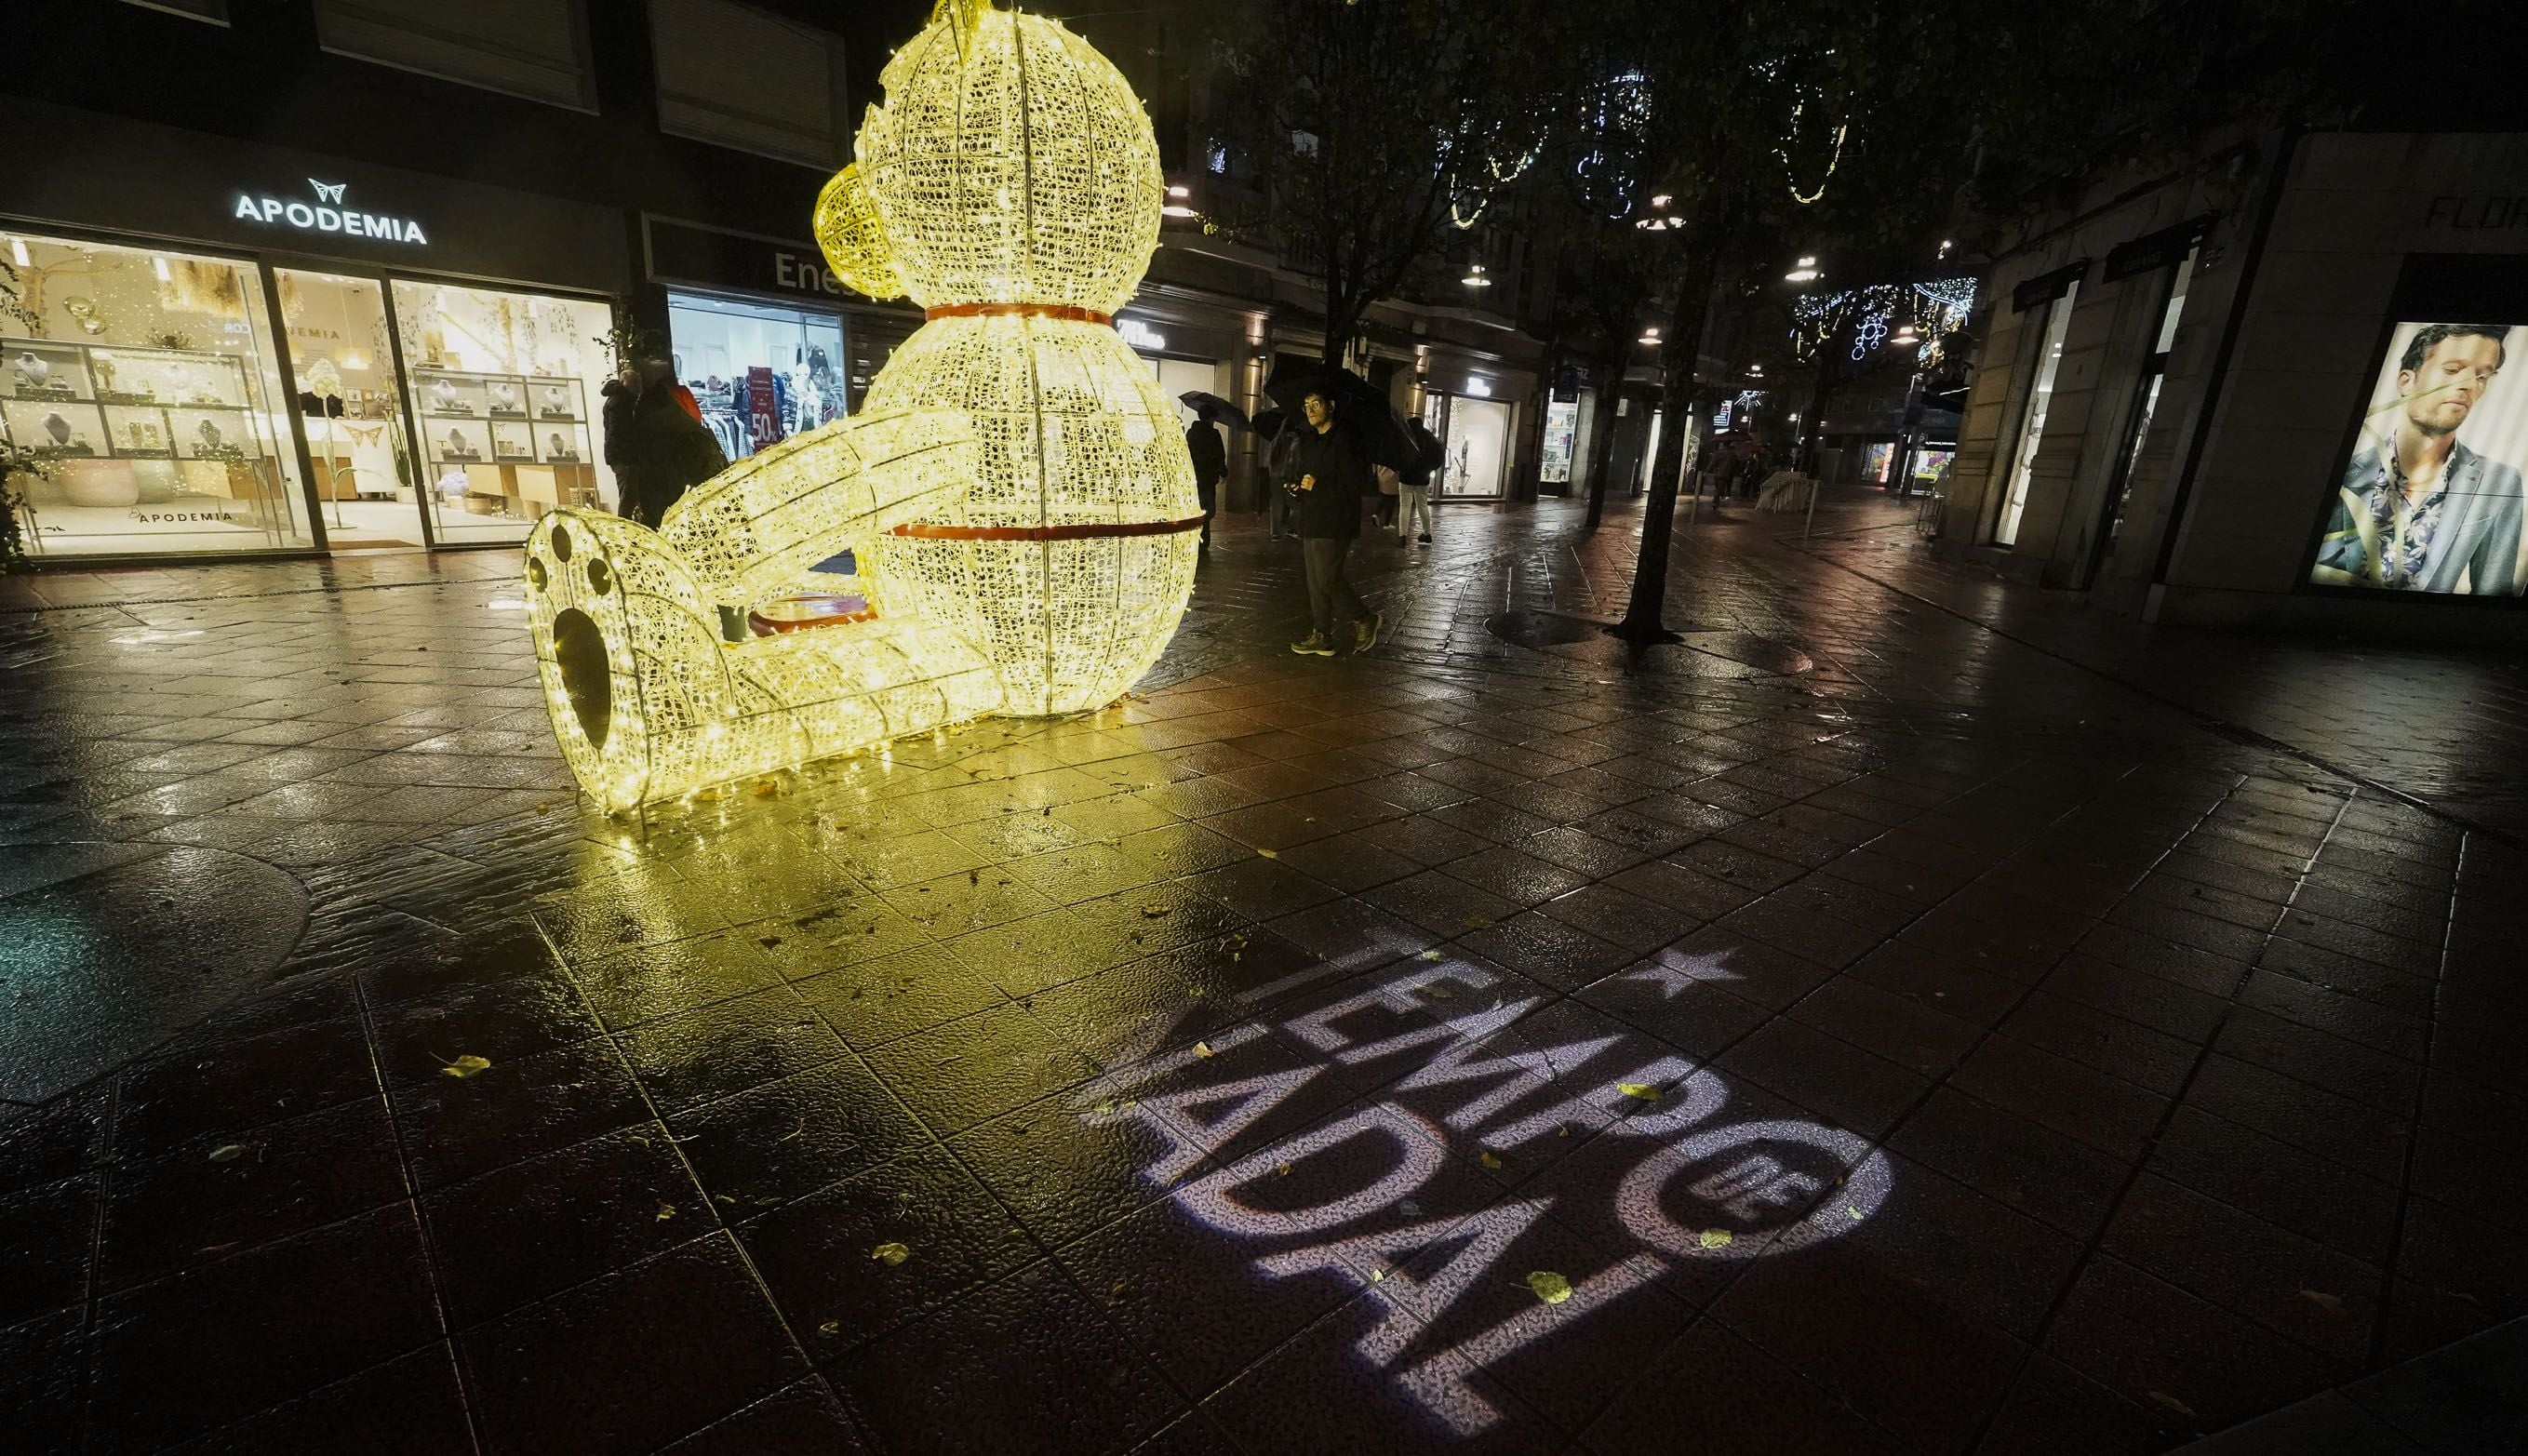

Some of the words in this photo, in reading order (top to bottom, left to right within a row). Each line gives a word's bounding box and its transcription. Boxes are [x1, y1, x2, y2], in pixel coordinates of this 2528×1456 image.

[234, 194, 428, 246] APODEMIA
[774, 252, 857, 296] Ene
[139, 512, 234, 524] APODEMIA
[1236, 928, 1894, 1262] TEMPO
[1688, 1152, 1822, 1221] DE
